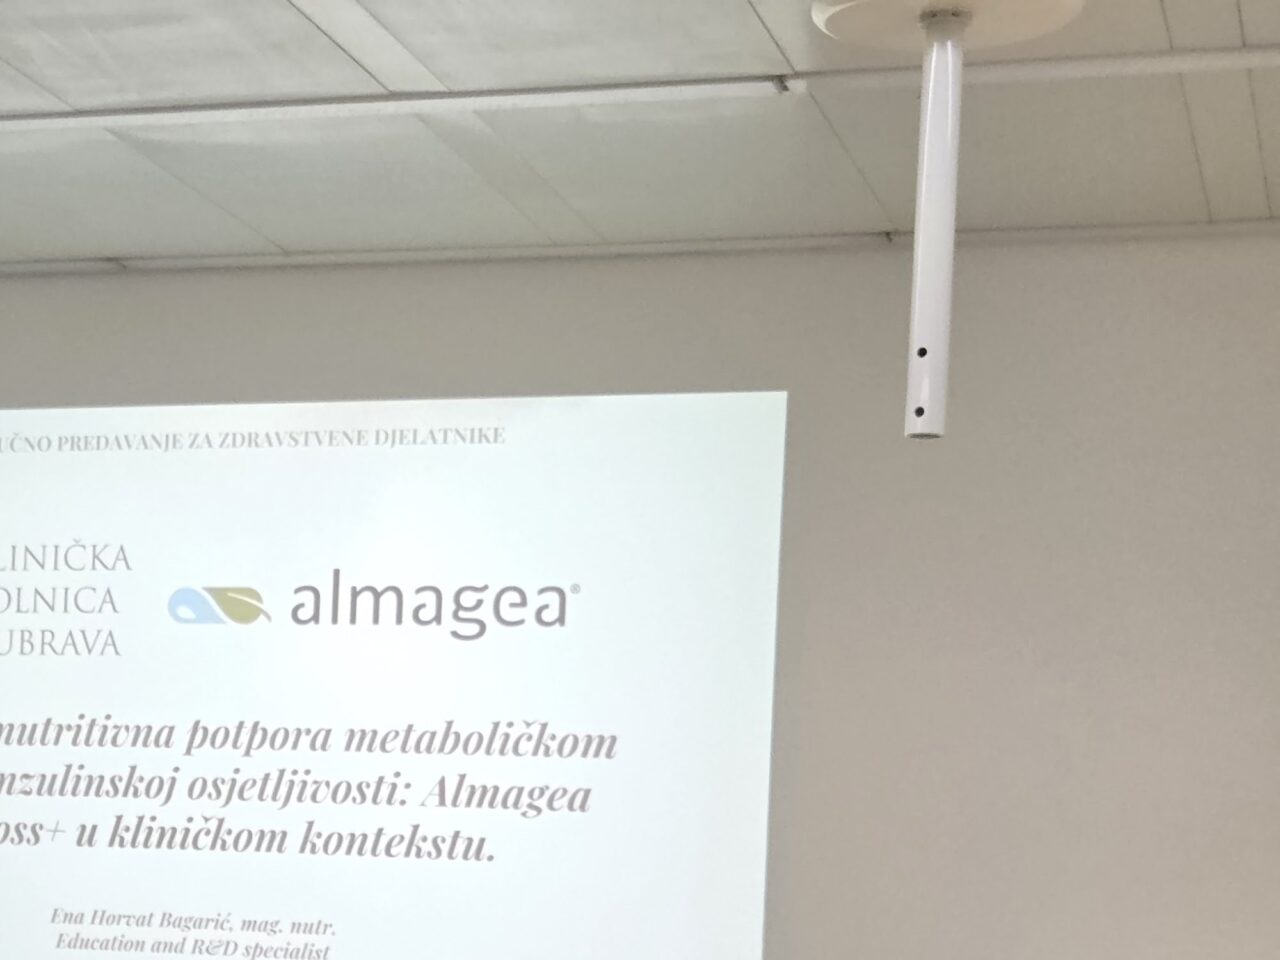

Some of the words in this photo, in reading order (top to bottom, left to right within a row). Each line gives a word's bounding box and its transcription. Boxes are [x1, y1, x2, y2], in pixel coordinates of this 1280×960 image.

[57, 432, 183, 453] PREDAVANJE
[187, 432, 214, 450] ZA
[218, 429, 369, 449] ZDRAVSTVENE
[374, 426, 506, 449] DJELATNIKE
[182, 719, 333, 758] potpora
[343, 719, 618, 760] metaboličkom
[187, 767, 412, 811] osjetljivosti:
[419, 772, 592, 819] Almagea
[75, 823, 99, 848] u
[107, 814, 288, 854] kliničkom
[298, 819, 495, 862] kontekstu.
[50, 907, 86, 925] Ena
[89, 908, 155, 928] Horvat
[240, 919, 283, 937] mag.
[289, 919, 336, 937] nutr.
[55, 931, 146, 953] Education
[150, 936, 188, 955] and
[190, 938, 239, 957] R&D
